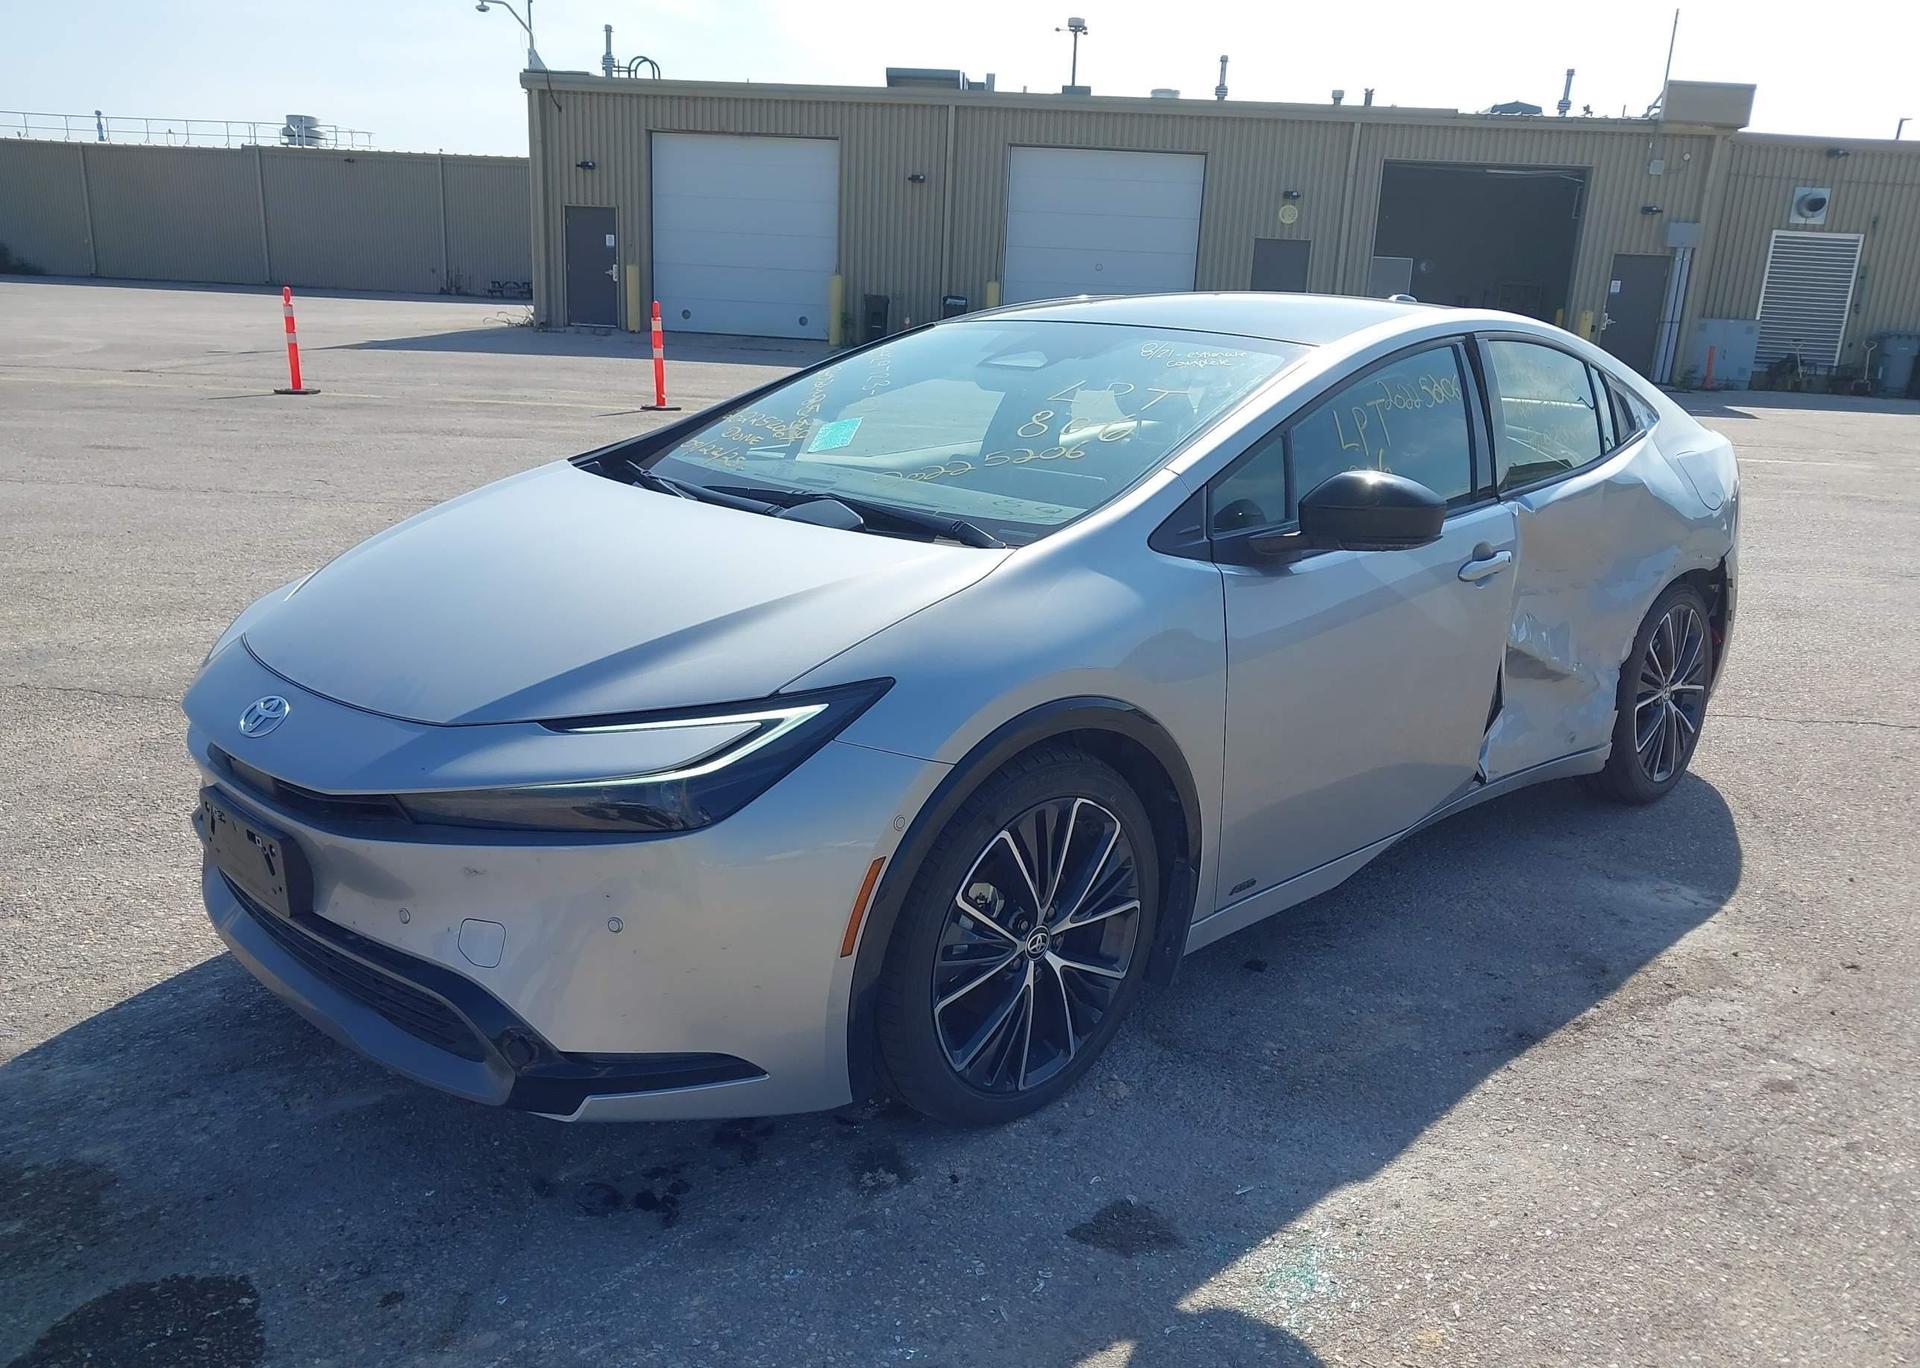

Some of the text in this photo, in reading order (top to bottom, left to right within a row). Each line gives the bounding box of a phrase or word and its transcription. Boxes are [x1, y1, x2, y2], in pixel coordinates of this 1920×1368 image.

[1140, 342, 1175, 360] 8/21
[1332, 398, 1391, 457] LPT
[984, 440, 1089, 467] 5206
